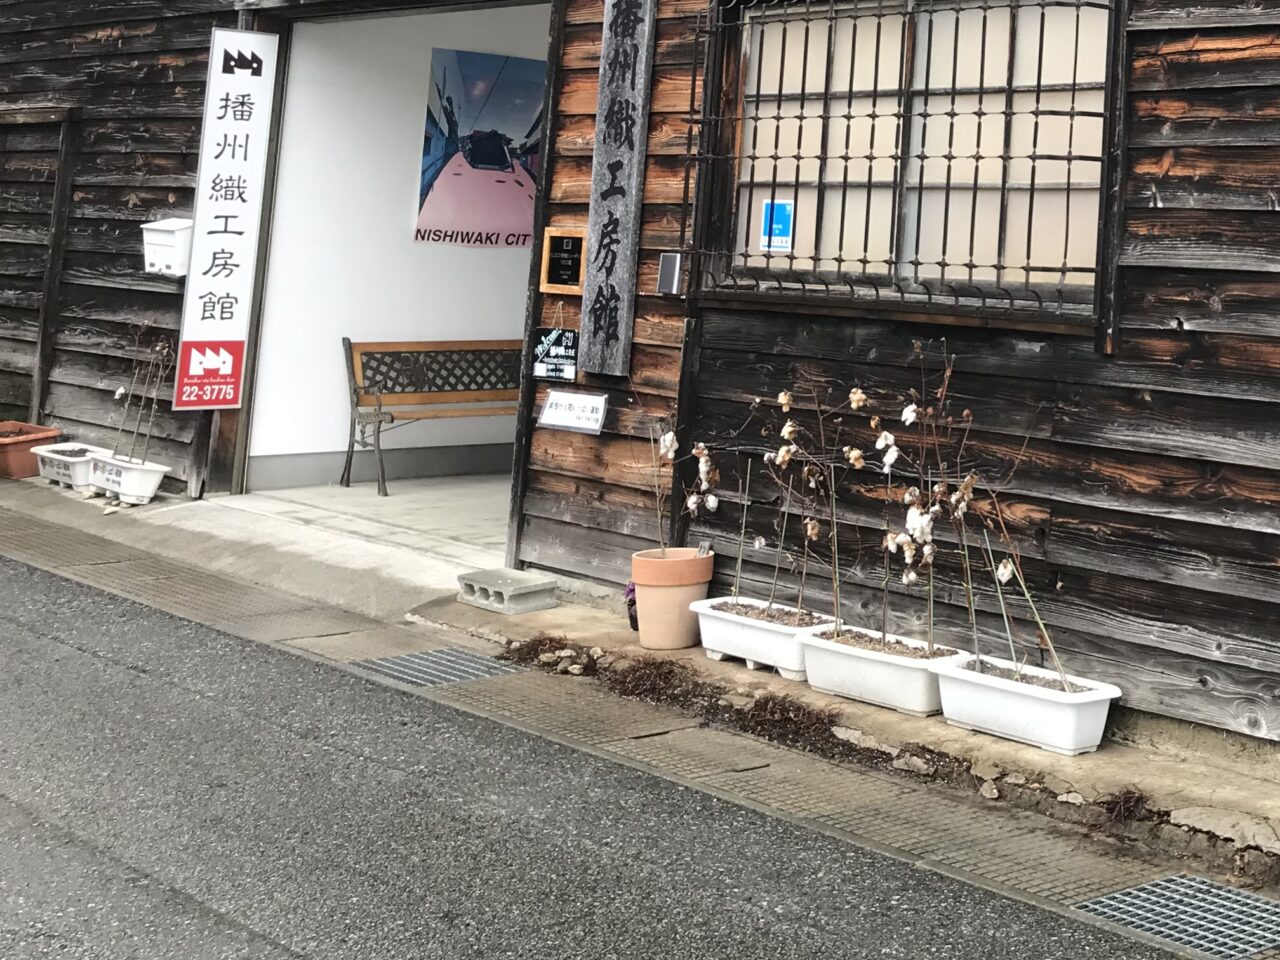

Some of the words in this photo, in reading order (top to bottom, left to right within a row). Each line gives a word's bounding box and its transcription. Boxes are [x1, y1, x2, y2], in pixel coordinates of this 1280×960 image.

[198, 92, 255, 322] 播州織工房館
[415, 228, 500, 245] NISHIWAKI
[505, 233, 531, 246] CIT
[182, 385, 234, 401] 22-3775
